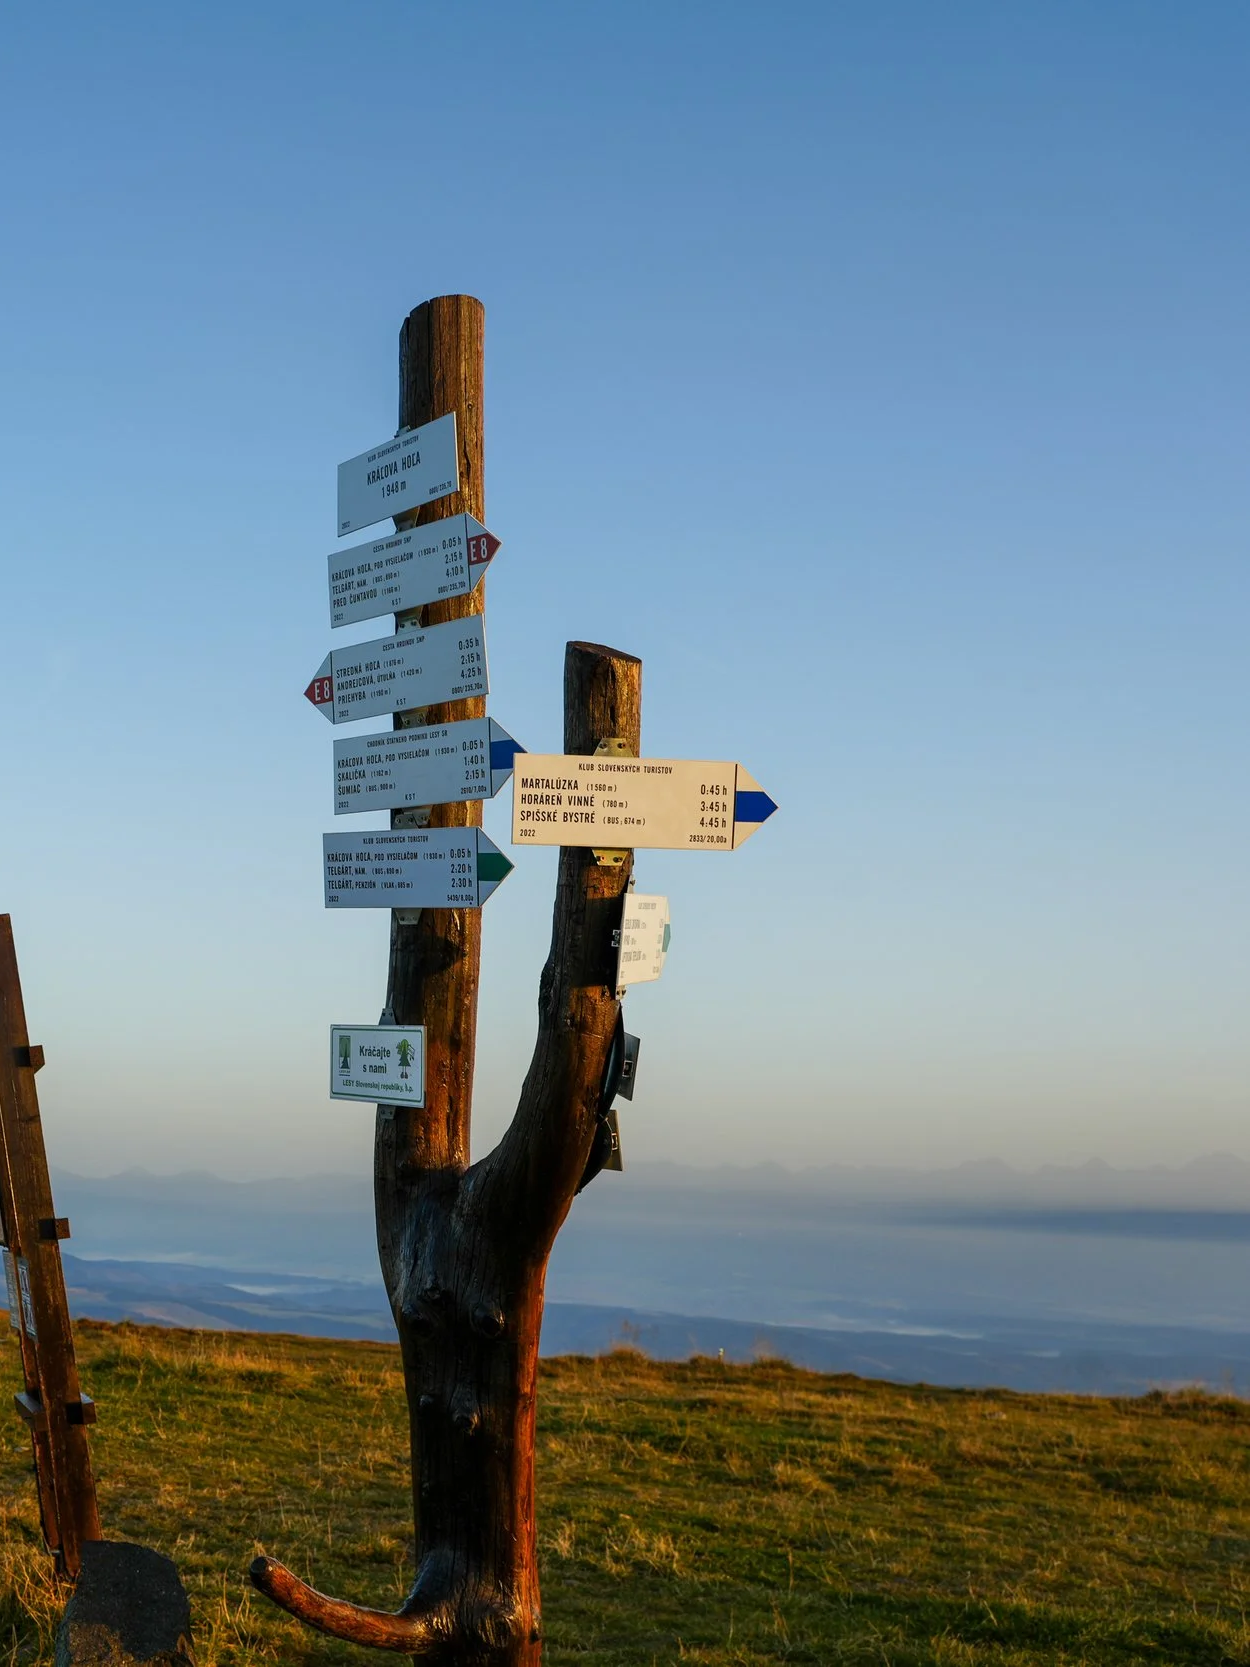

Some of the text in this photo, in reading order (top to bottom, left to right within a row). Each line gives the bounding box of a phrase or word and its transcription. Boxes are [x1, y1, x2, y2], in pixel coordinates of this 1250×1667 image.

[367, 451, 421, 486] KRÁĽOVA HOĽA
[442, 538, 457, 550] 0:05
[445, 553, 458, 565] 2:15
[331, 567, 355, 582] KRÁĽOVA
[446, 567, 458, 578] 4:10
[333, 594, 347, 609] PRED
[349, 588, 377, 604] ČUNTAVOU
[382, 643, 395, 652] CESTA
[458, 638, 473, 651] 0:35
[460, 653, 474, 666] 2:15
[336, 664, 362, 679] STREDNÁ
[365, 659, 381, 671] HOĽA
[460, 667, 475, 679] 4:25
[338, 690, 366, 704] PRIEHYBA
[338, 709, 349, 718] 2022
[429, 731, 440, 739] LESY
[462, 740, 478, 751] 0:05
[337, 754, 363, 769] KRÁĽOVA
[385, 753, 395, 762] POD
[398, 749, 430, 761] VYSIELAČOM
[464, 755, 479, 766] 1:40
[337, 768, 366, 782] SKALIČKA
[465, 769, 480, 780] 2:15
[578, 763, 673, 775] KLUB SLOVENSKÝCH TURISTOV
[338, 782, 361, 796] ŠUMIAC
[521, 777, 579, 791] MARTALÚZKA
[700, 784, 720, 796] 0:45
[338, 800, 349, 808] 2022
[521, 793, 563, 807] HORÁREŇ
[568, 793, 595, 808] VINNÉ
[700, 801, 720, 813] 3:45
[520, 809, 558, 823] SPIŠSKÉ
[562, 810, 595, 825] BYSTRÉ
[699, 817, 719, 828] 4:45
[519, 829, 536, 838] 2022
[327, 850, 353, 863] KRÁĽOVA
[374, 852, 385, 861] POD
[387, 850, 418, 861] VYSIELAČOM
[450, 848, 466, 859] 0:05
[327, 864, 354, 877] TELGÁRT,
[450, 864, 466, 874] 2:20
[328, 878, 354, 891] TELGÁRT,
[451, 878, 466, 888] 2:30
[328, 895, 339, 903] 2022
[359, 1045, 391, 1060] Kráčajte
[369, 1062, 387, 1074] nami
[342, 1079, 355, 1087] LESY
